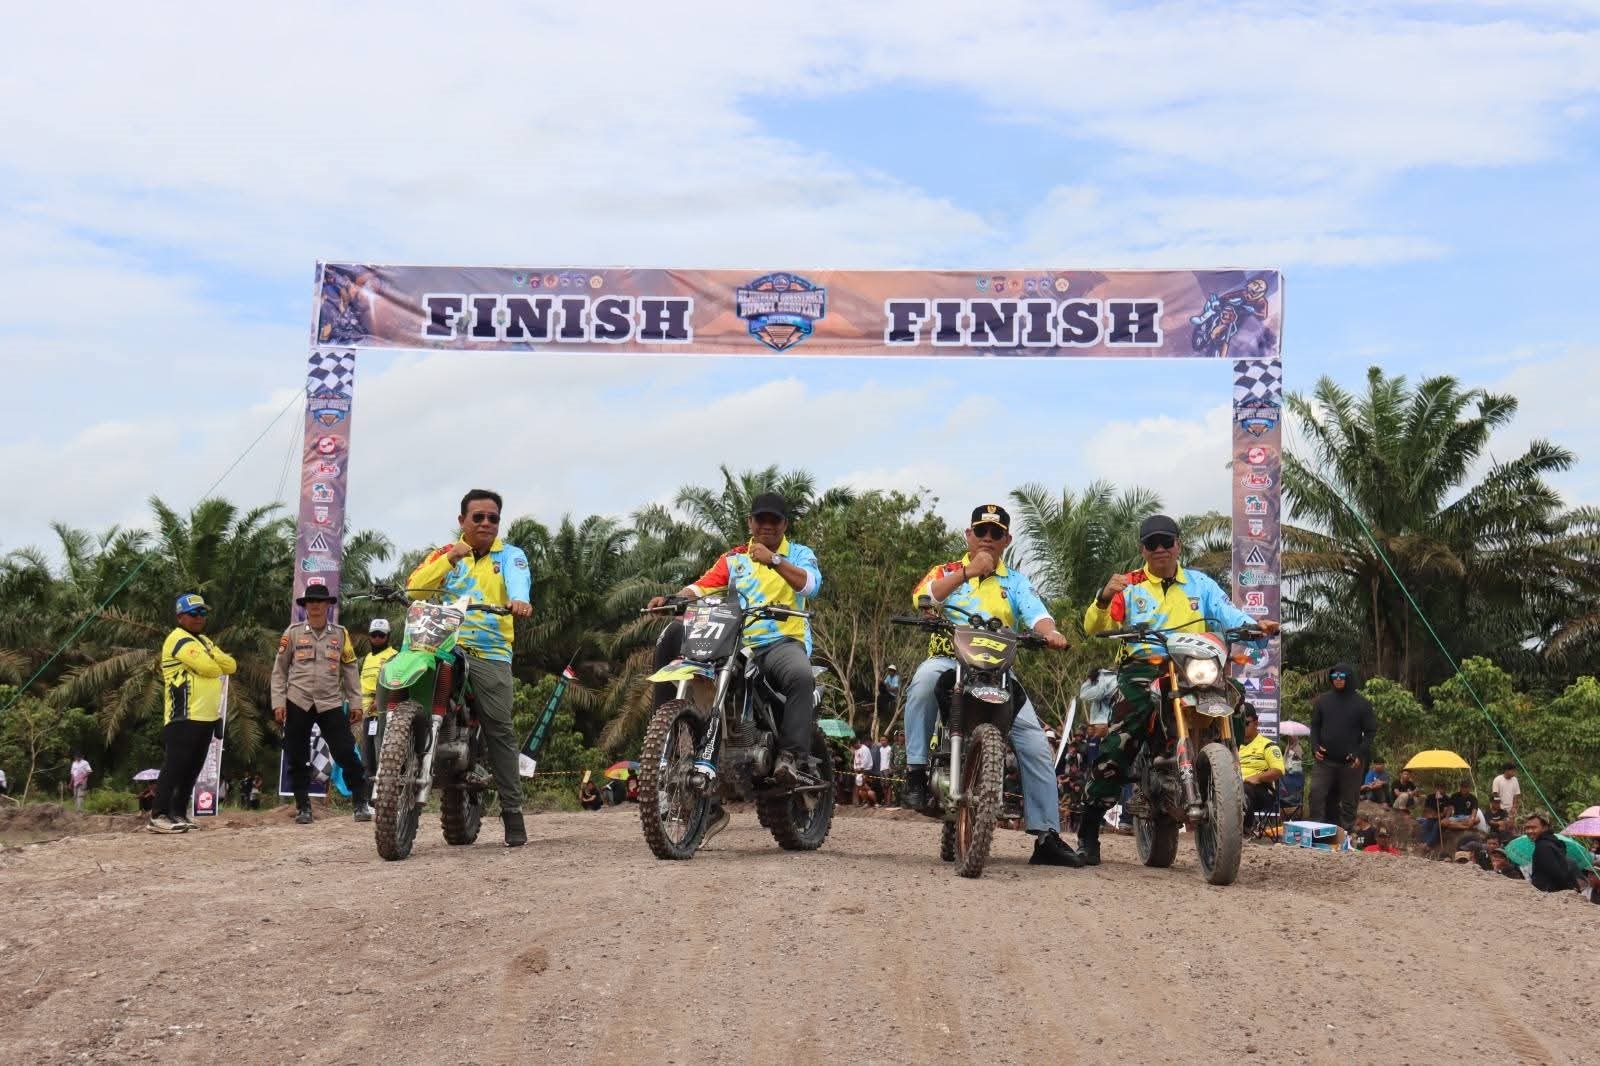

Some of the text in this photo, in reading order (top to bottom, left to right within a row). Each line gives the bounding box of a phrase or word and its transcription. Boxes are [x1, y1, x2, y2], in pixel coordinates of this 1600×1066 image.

[422, 294, 693, 344] FINISH
[885, 298, 1163, 347] FINISH
[688, 621, 726, 640] 271
